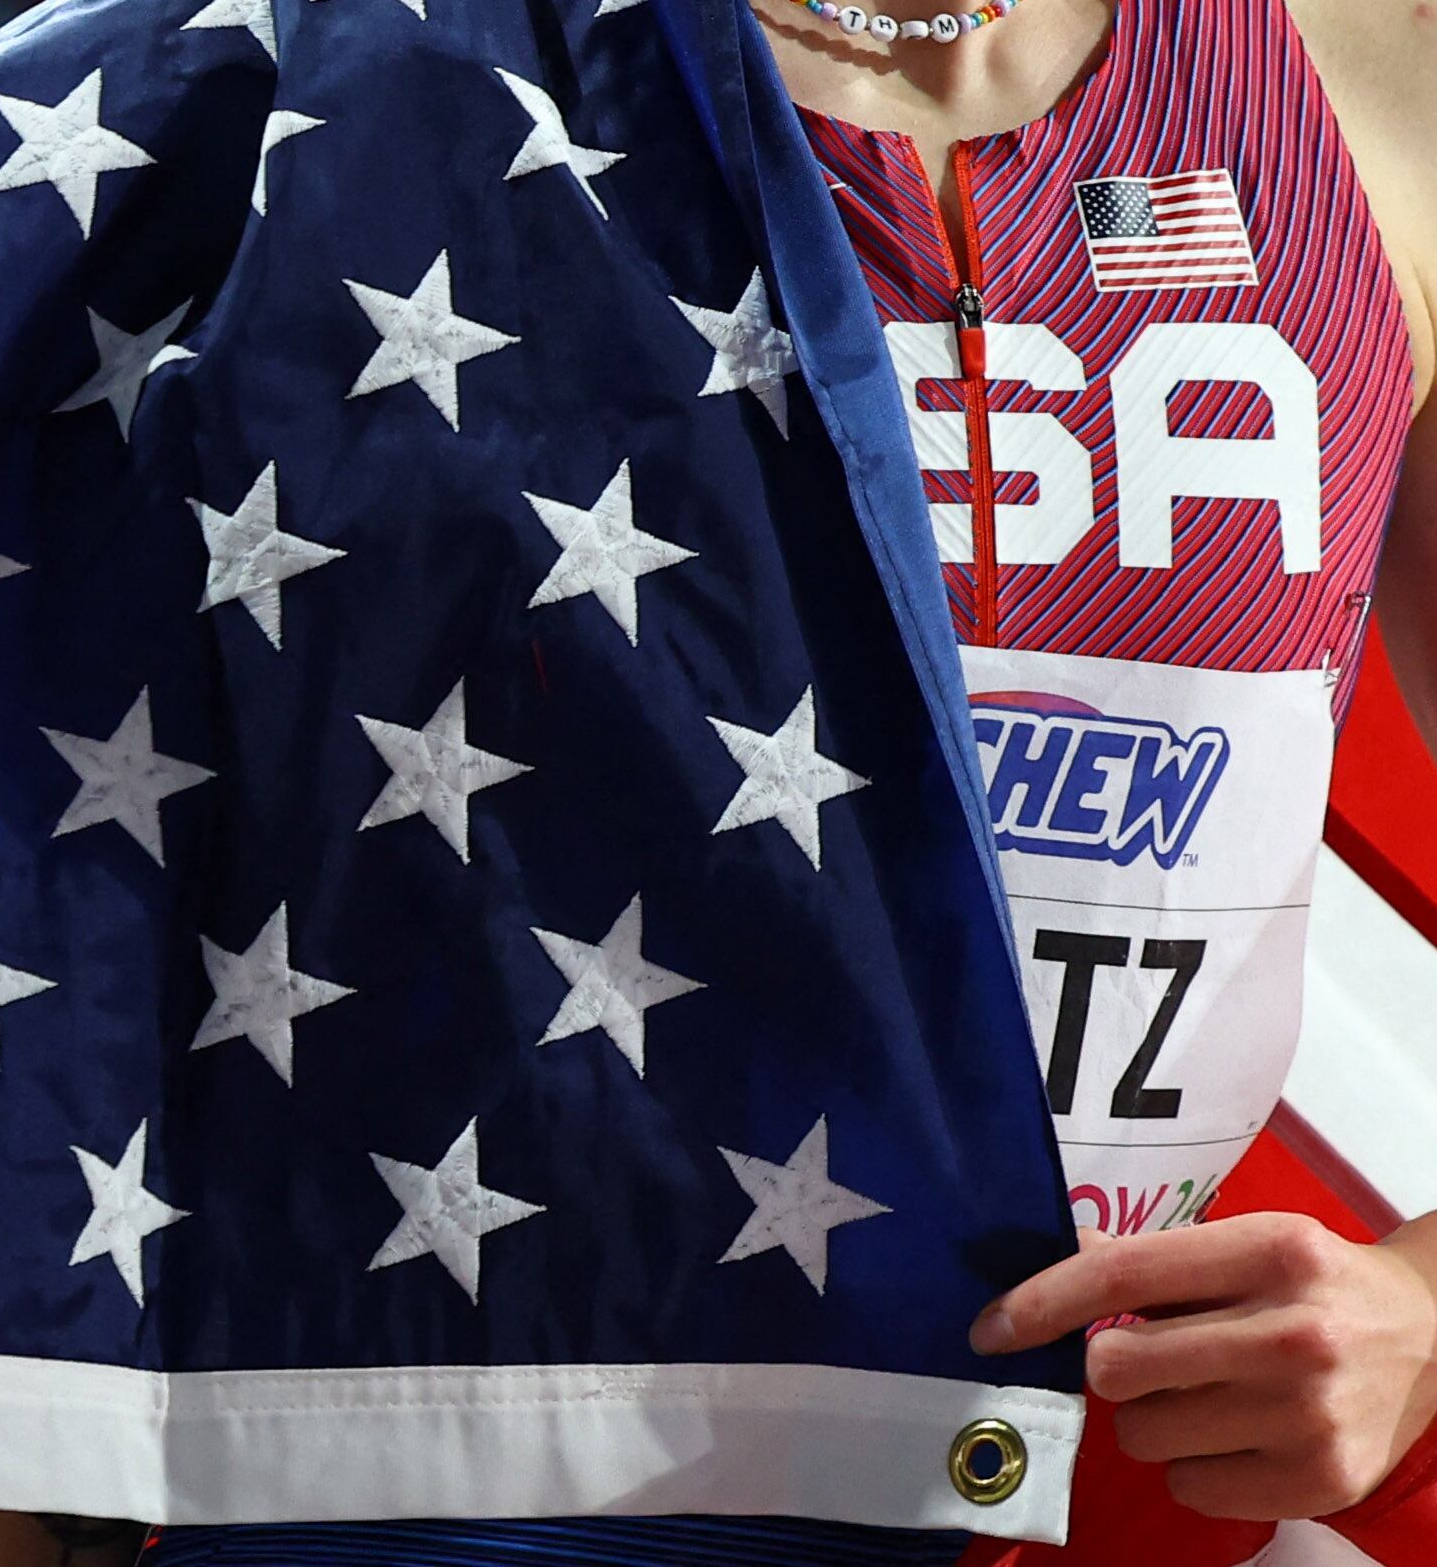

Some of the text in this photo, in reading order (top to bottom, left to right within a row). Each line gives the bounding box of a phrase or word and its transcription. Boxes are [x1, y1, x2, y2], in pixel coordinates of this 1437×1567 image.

[846, 9, 957, 38] THM
[972, 715, 1222, 853] HEW
[1032, 929, 1207, 1119] TZ
